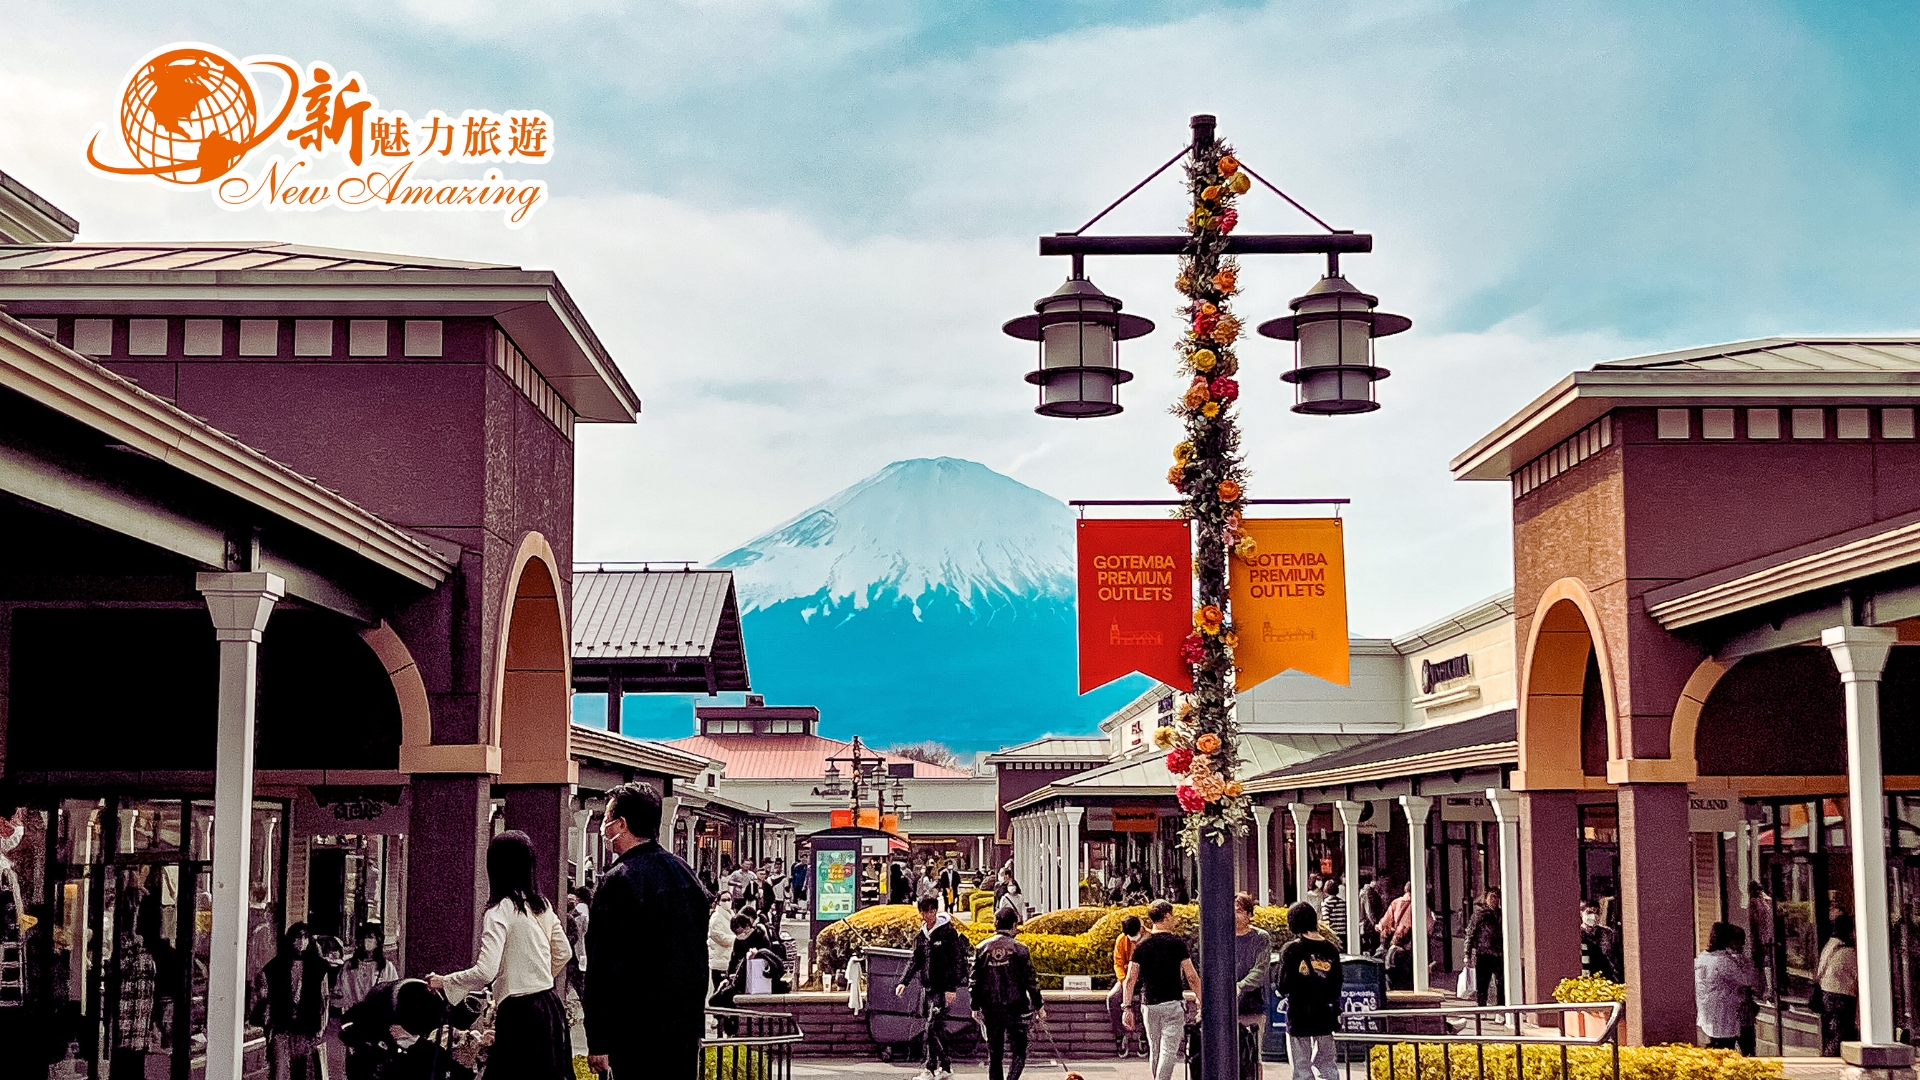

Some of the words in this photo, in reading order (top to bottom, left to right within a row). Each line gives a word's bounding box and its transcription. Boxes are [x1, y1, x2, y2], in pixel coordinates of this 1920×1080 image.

[1093, 555, 1176, 570] GOTEMBA
[1245, 553, 1328, 568] GOTEMBA
[1097, 571, 1173, 586] PREMIUM
[1250, 568, 1325, 583] PREMIUM
[1097, 587, 1173, 602] OUTLETS
[1251, 584, 1325, 599] OUTLETS
[1689, 799, 1728, 810] ISLAND
